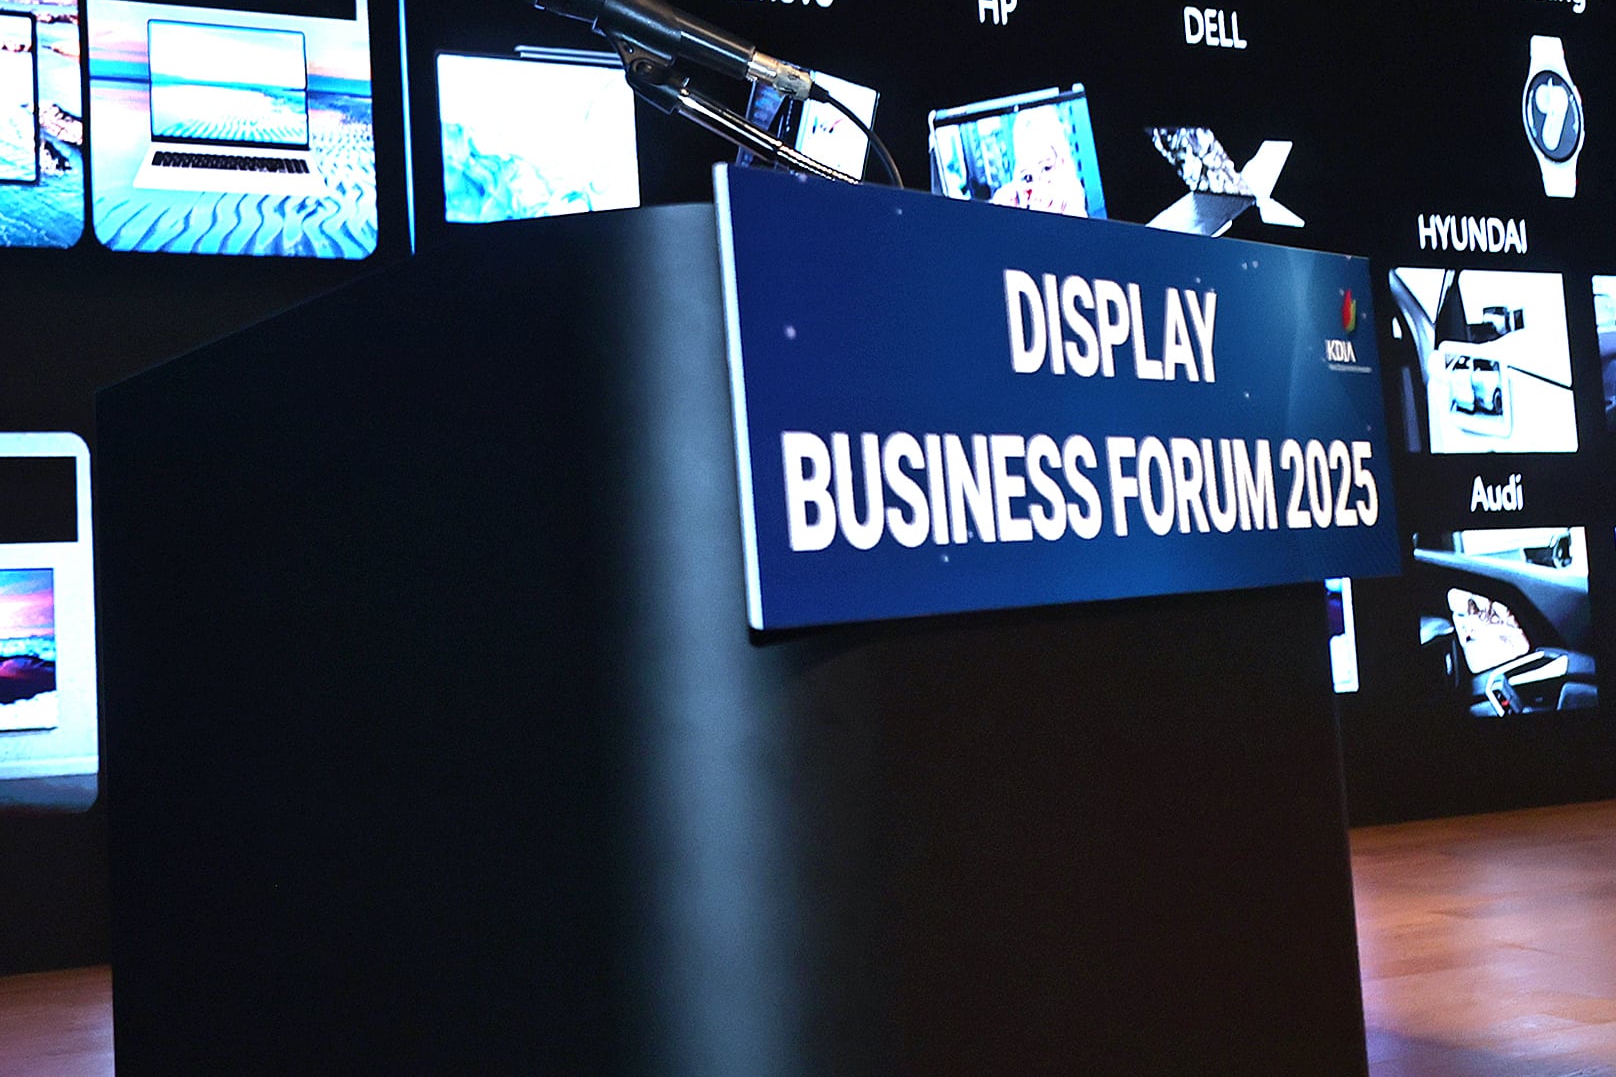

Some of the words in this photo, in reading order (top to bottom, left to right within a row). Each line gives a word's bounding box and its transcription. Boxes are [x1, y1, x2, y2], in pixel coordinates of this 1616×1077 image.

[1184, 7, 1248, 49] DELL
[1418, 214, 1528, 254] HYUNDAI
[1003, 268, 1218, 383] DISPLAY
[1325, 339, 1356, 362] KDIA
[782, 430, 1101, 553] BUSINESS
[1107, 435, 1279, 538] FORUM
[1280, 439, 1379, 529] 2025
[1470, 474, 1524, 513] Audi
